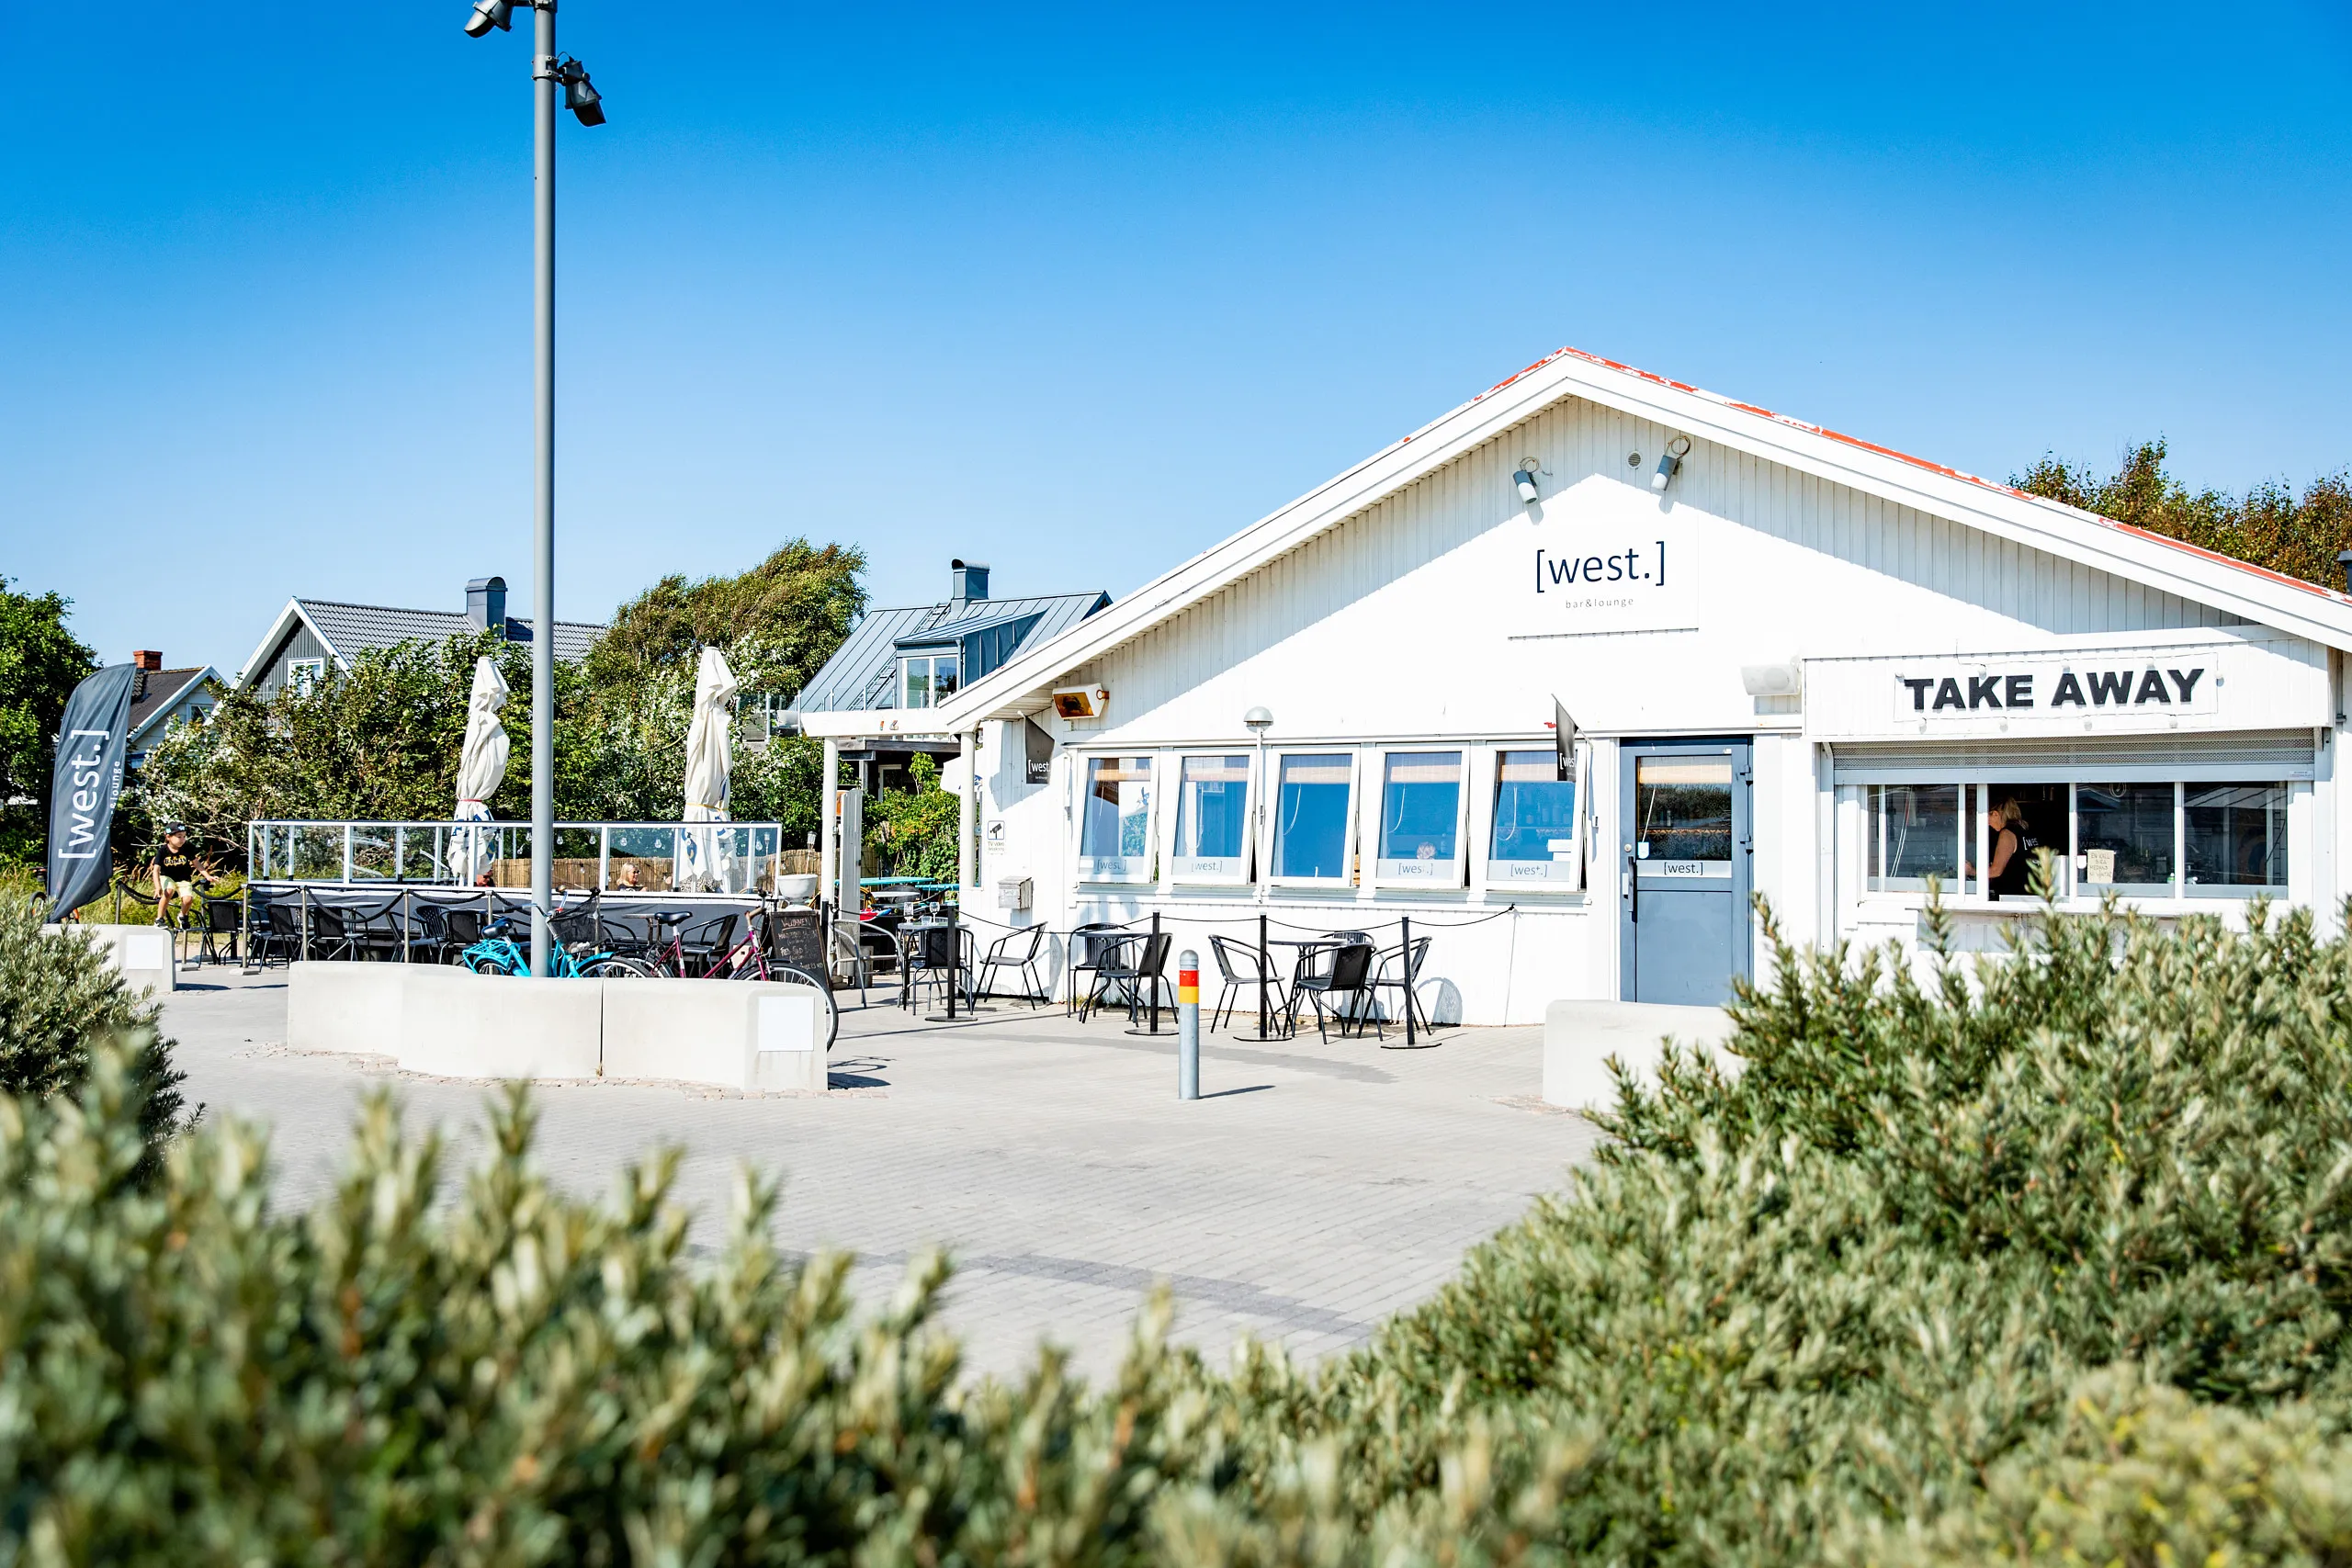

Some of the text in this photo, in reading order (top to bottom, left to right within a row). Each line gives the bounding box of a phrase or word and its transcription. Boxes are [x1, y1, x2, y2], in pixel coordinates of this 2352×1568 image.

[1537, 541, 1665, 593] [west.]
[1566, 598, 1634, 608] bar&lounge
[1904, 668, 2205, 710] TAKE AWAY
[1028, 759, 1050, 774] [west.
[1559, 752, 1575, 770] [wes
[58, 729, 110, 859] [west.]
[106, 761, 122, 829] &lounge
[1398, 863, 1433, 875] [wes.]
[1664, 862, 1703, 875] [west.]
